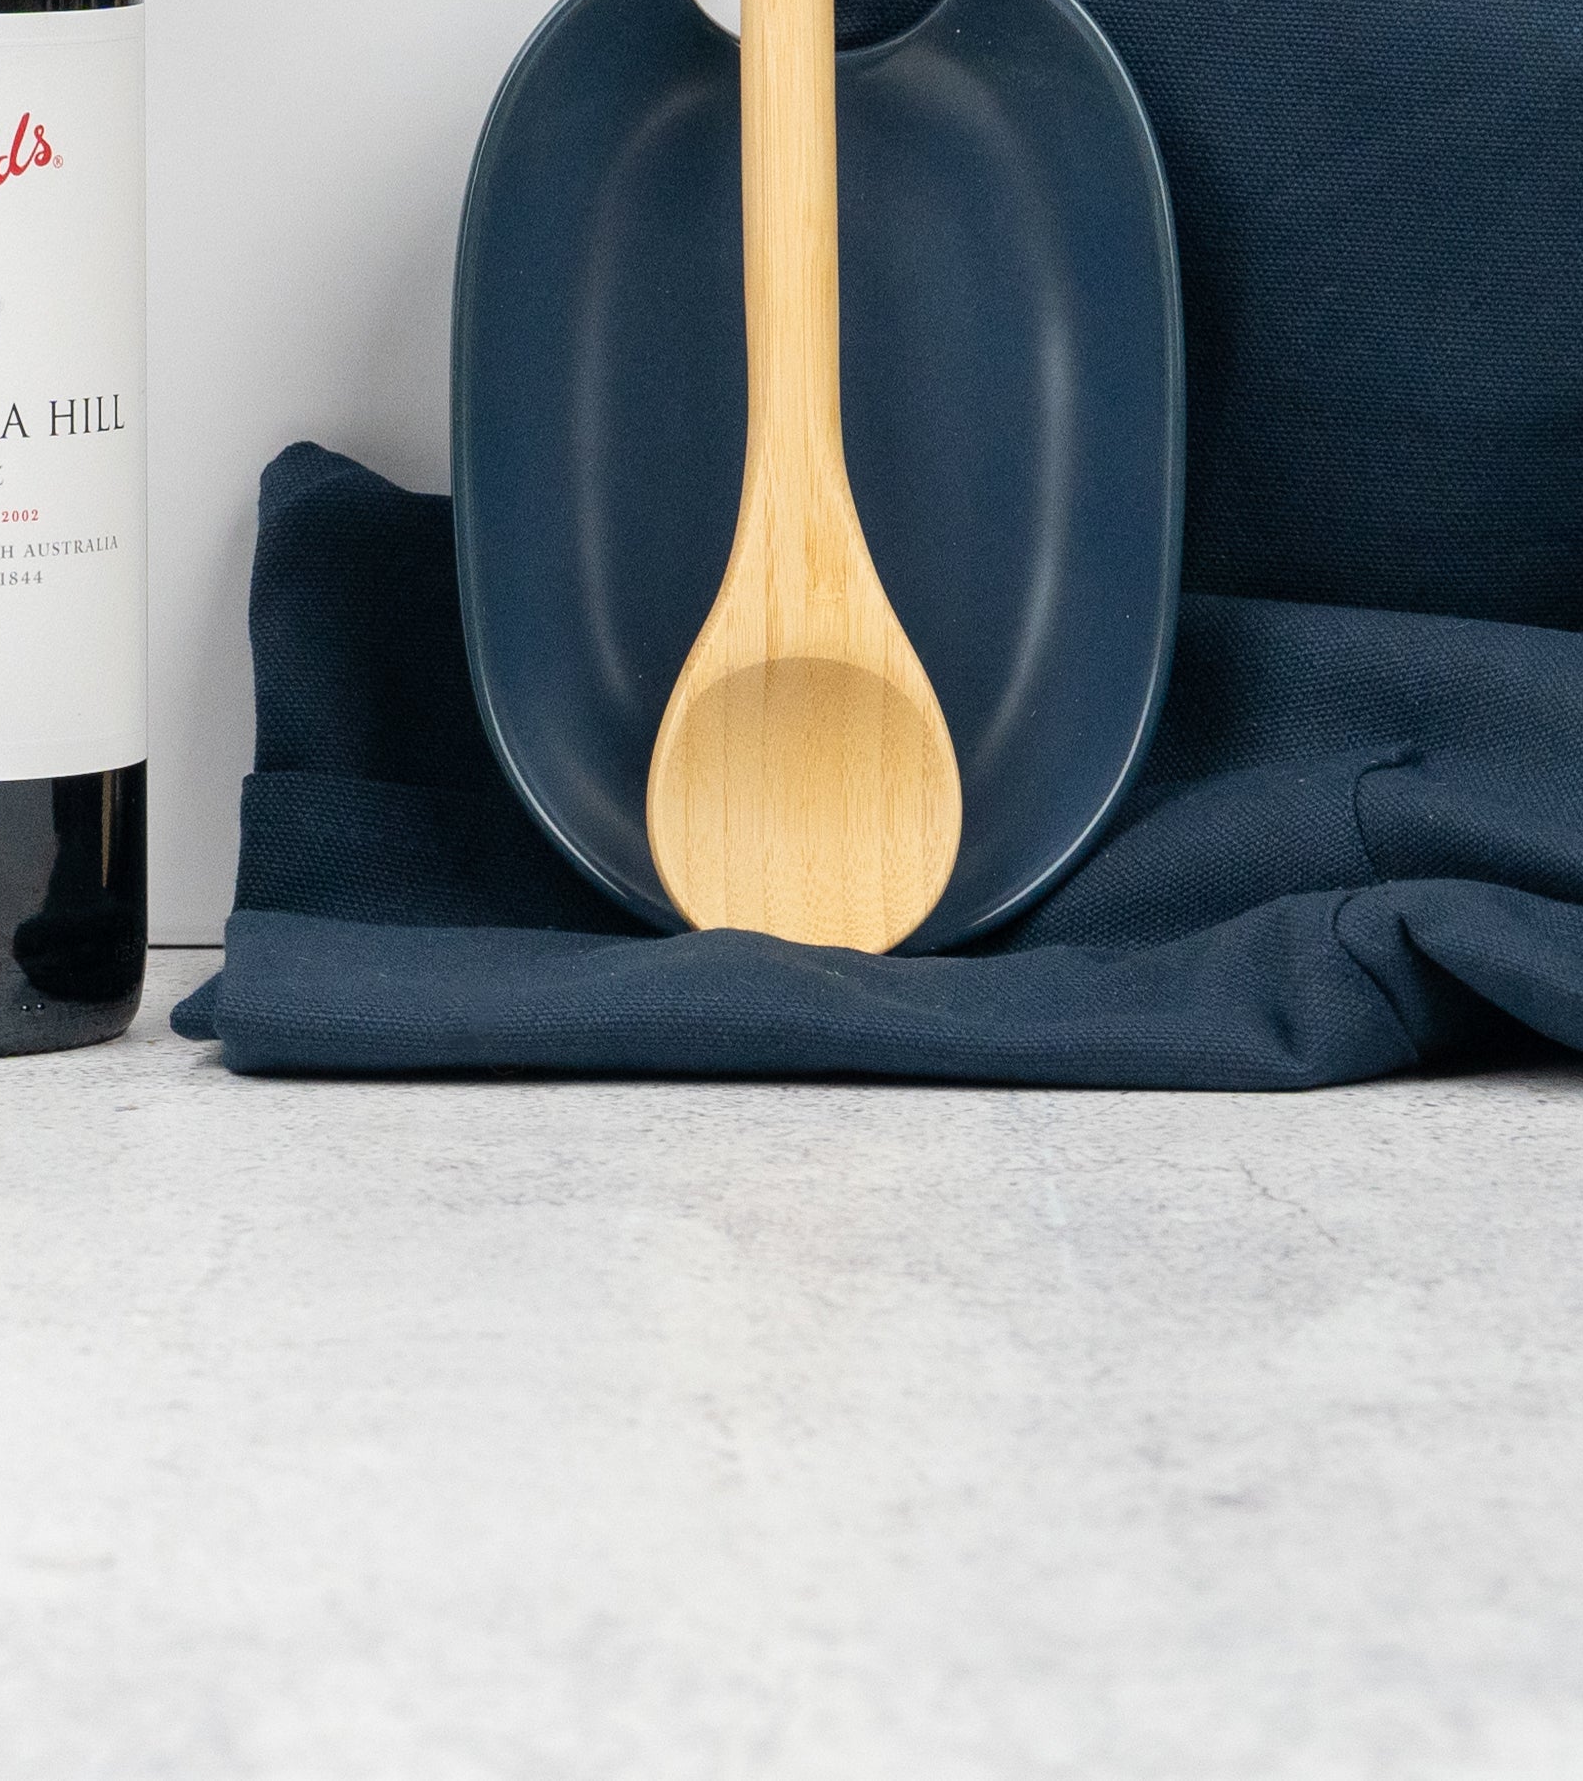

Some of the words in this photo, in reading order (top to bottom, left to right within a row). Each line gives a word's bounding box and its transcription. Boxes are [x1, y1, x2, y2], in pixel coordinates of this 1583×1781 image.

[49, 393, 126, 437] HILL
[1, 509, 40, 523] 2002
[23, 534, 119, 559] AUSTRALIA
[0, 570, 44, 586] 1844
